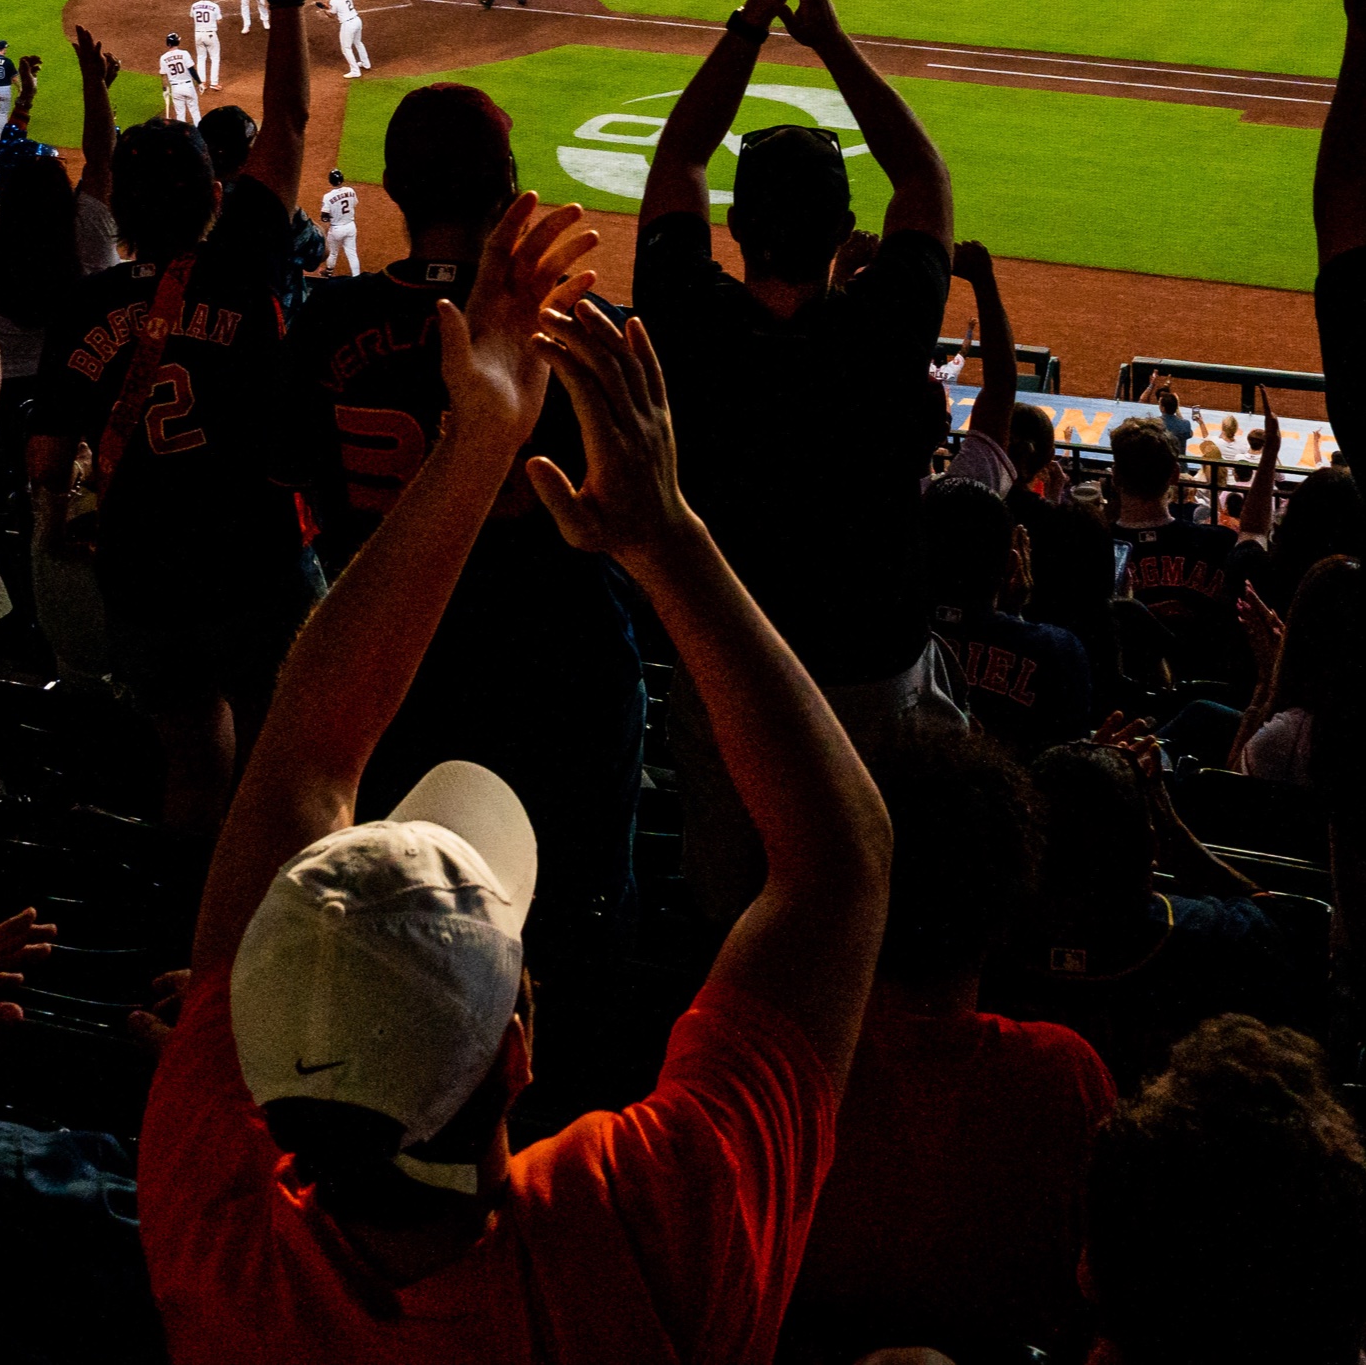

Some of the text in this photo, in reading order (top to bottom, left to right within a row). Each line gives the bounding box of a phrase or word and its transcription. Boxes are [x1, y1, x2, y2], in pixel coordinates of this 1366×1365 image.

[195, 10, 211, 23] 20
[167, 62, 185, 76] 30
[340, 200, 350, 214] 2
[144, 362, 207, 455] 2
